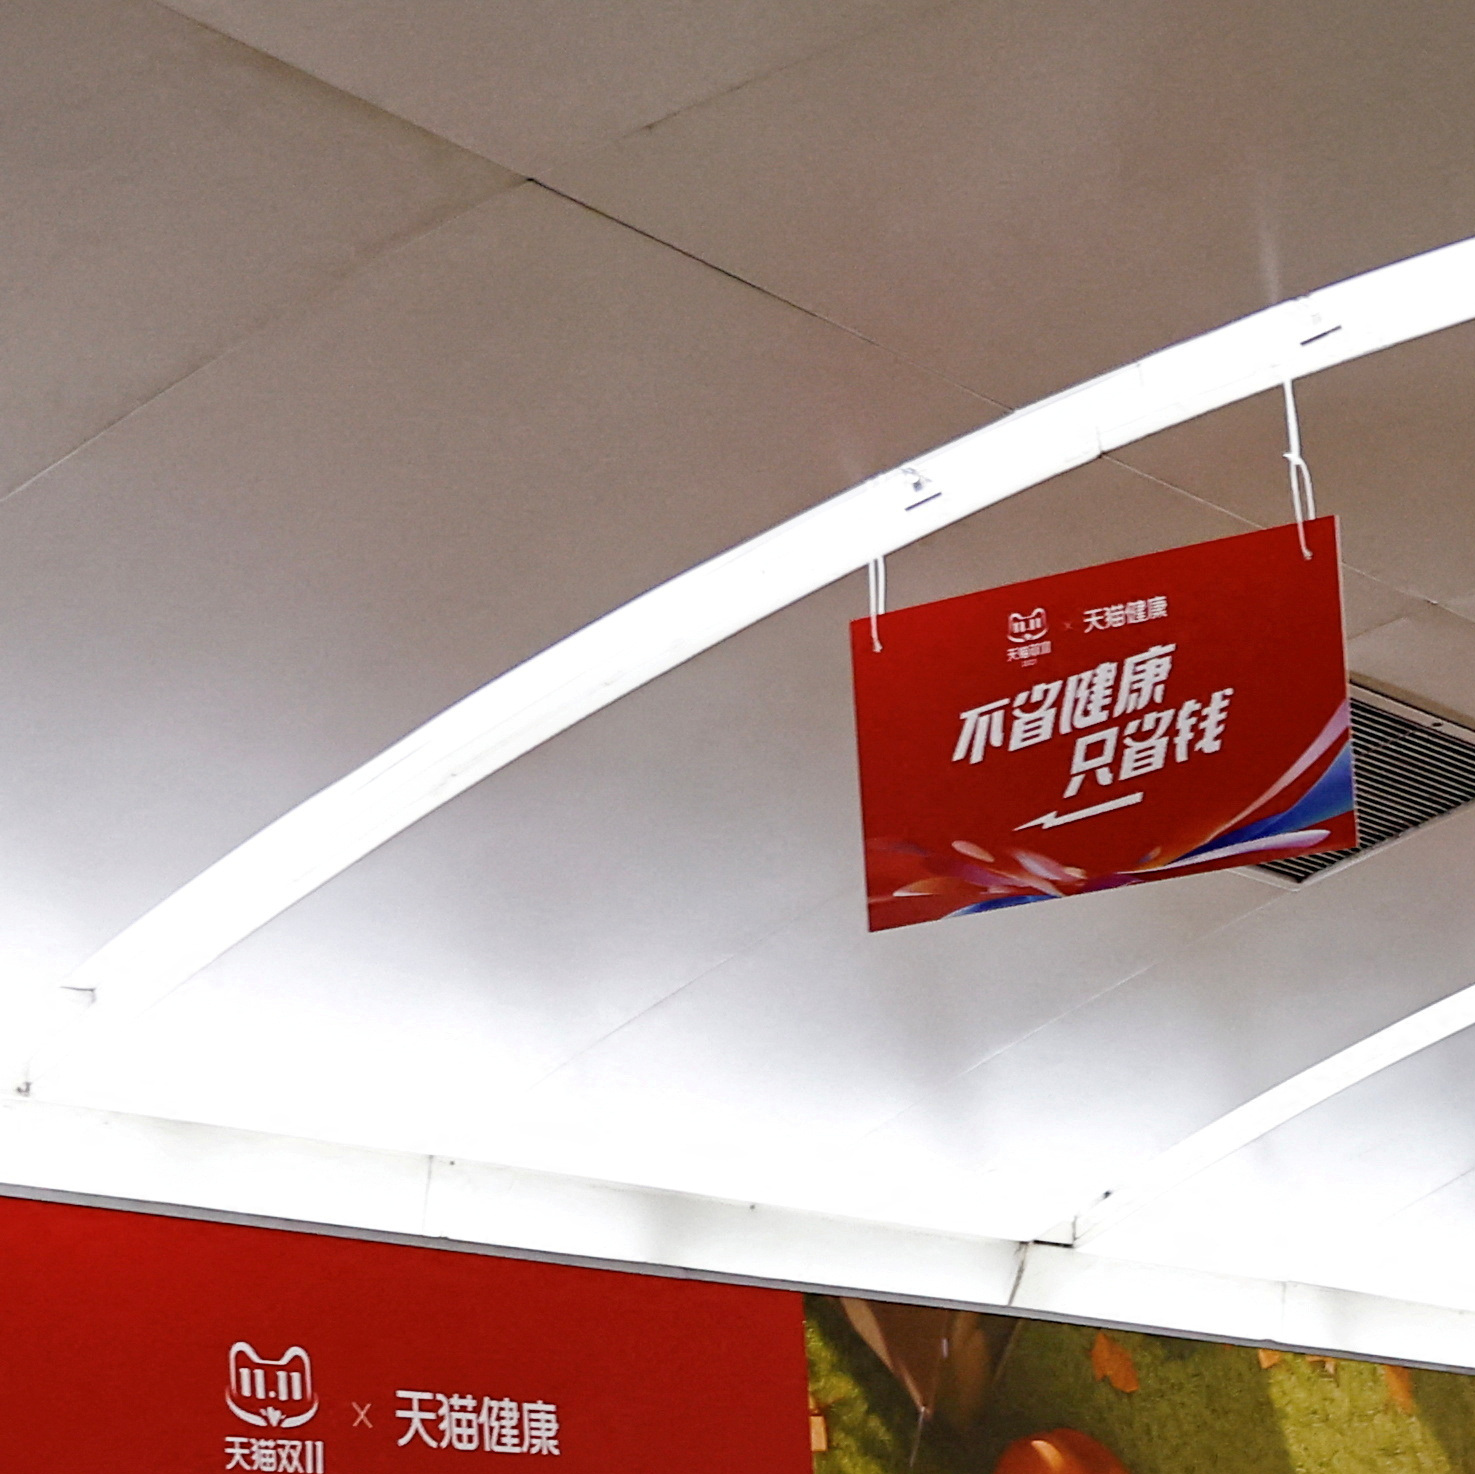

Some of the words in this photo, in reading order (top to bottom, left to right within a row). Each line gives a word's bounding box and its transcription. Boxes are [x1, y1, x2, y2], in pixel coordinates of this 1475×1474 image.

[1083, 595, 1168, 633] 天猫健康
[952, 643, 1176, 765] 不省健康
[1063, 687, 1234, 799] 只省钱
[395, 1389, 561, 1456] 天猫健康
